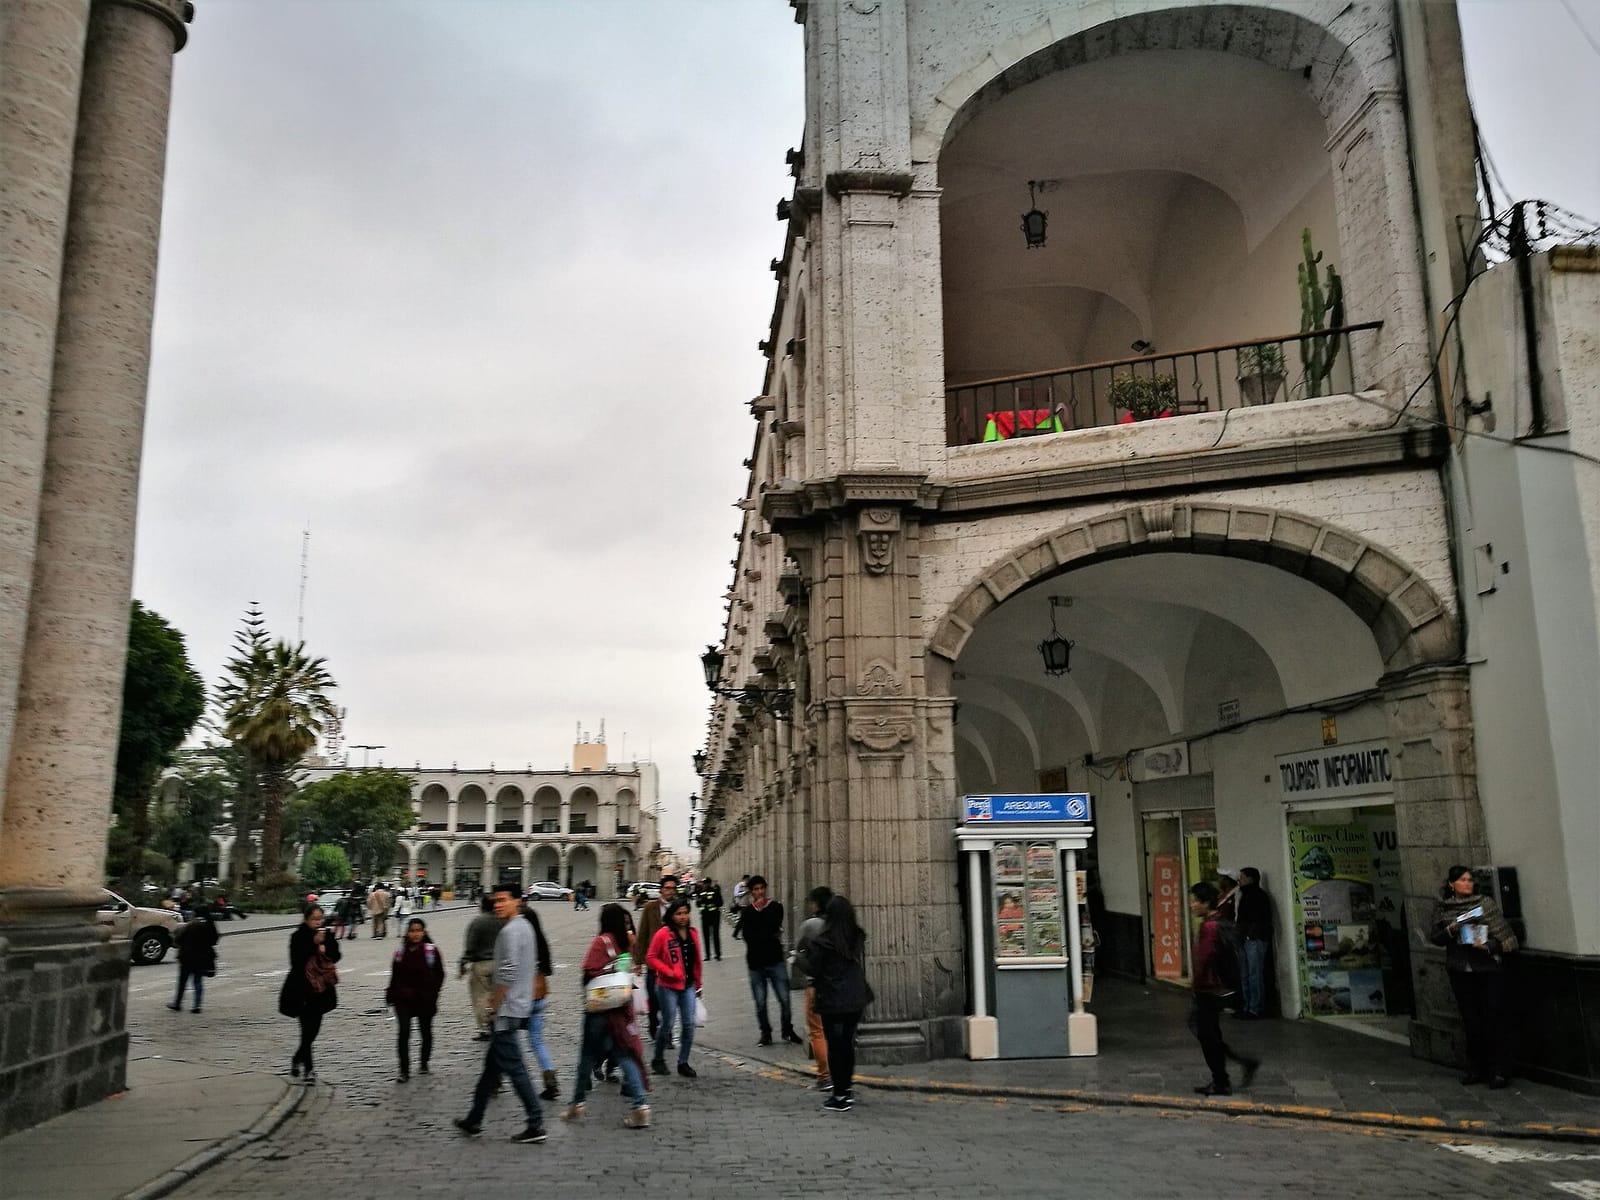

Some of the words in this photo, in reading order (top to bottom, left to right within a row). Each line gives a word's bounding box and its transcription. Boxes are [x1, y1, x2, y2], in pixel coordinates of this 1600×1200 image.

[1280, 760, 1320, 792] TOURIST
[1003, 801, 1052, 811] AREQUIPA
[1298, 829, 1331, 843] Tours
[1160, 867, 1173, 965] BOTICA
